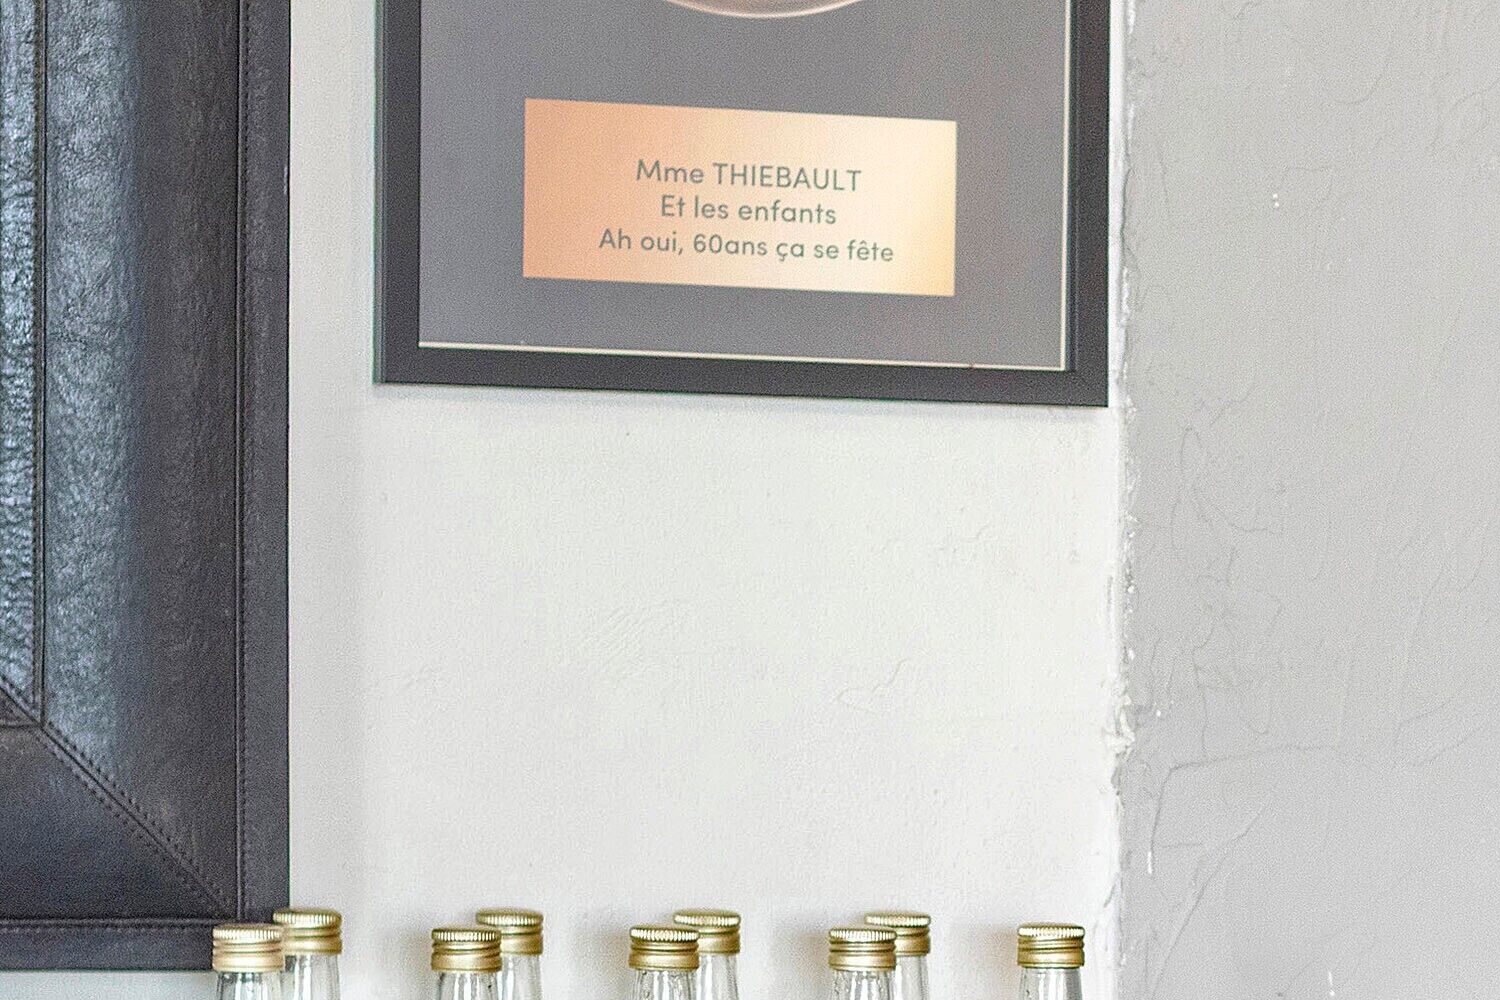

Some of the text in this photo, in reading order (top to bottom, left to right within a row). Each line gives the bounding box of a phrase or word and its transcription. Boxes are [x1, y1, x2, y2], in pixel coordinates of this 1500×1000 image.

[636, 159, 862, 192] Mme THIEBAULT
[661, 196, 837, 225] Et les enfants
[599, 228, 894, 262] Ah oui, 60ans ça se fête
